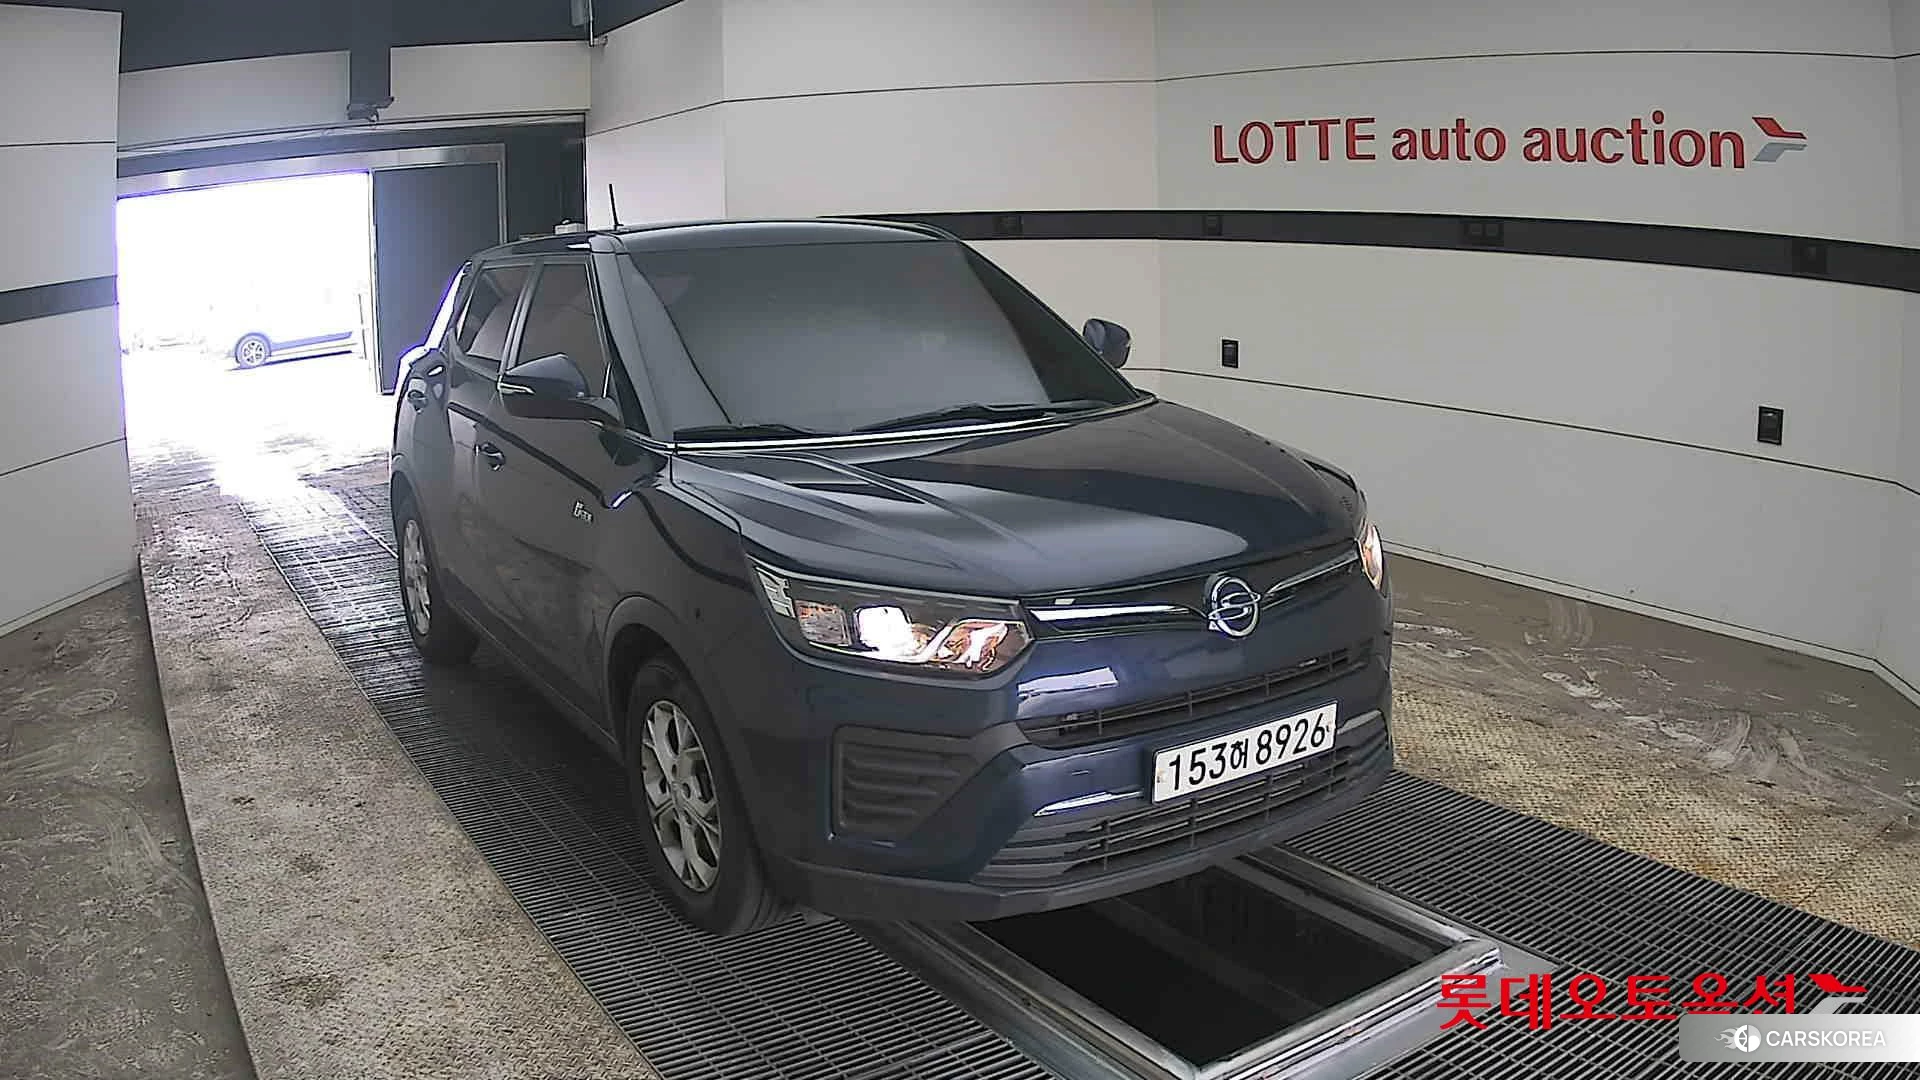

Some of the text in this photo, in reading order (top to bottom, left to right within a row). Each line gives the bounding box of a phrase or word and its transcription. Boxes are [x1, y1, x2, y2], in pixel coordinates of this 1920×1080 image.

[1212, 109, 1746, 169] LOTTE auto auction
